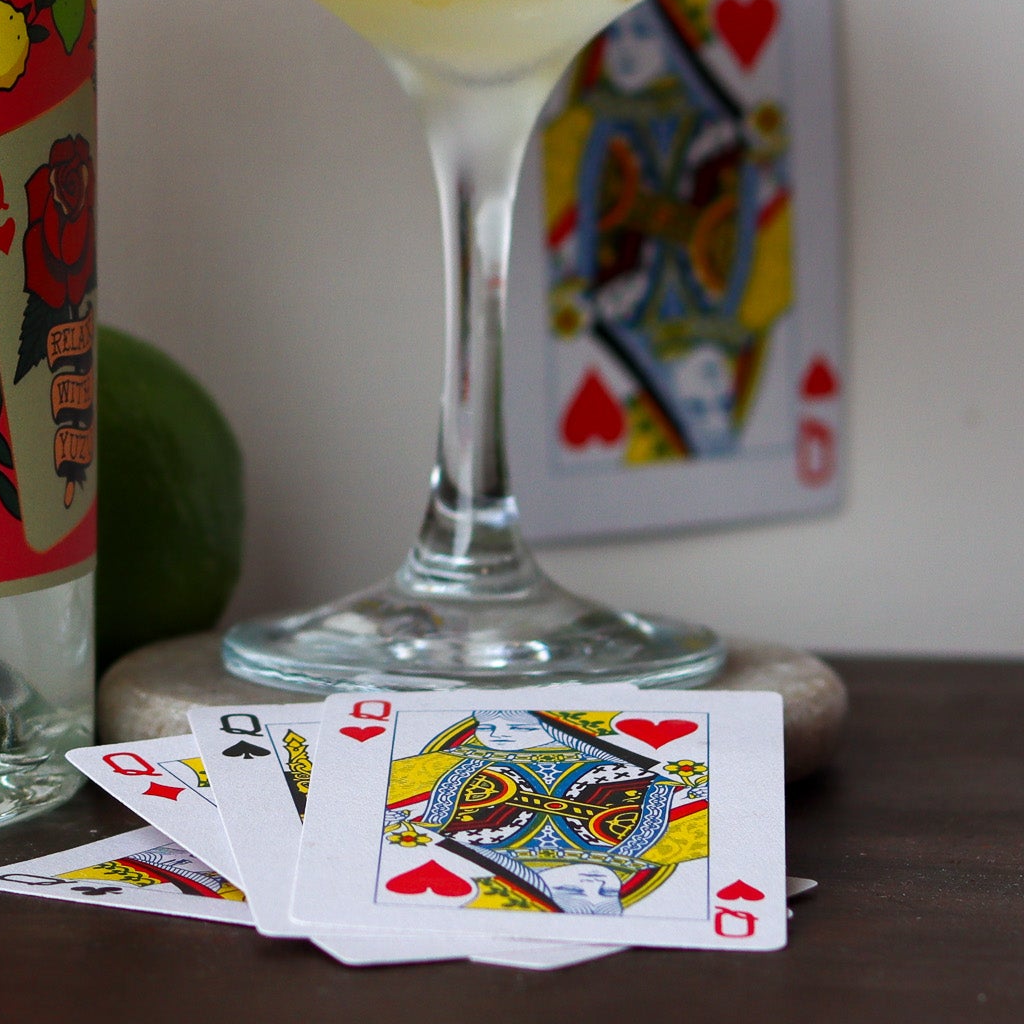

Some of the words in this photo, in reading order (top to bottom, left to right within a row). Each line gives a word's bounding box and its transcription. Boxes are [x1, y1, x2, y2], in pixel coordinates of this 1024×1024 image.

[348, 699, 393, 722] Q
[219, 712, 264, 737] Q
[102, 751, 164, 777] Q
[714, 905, 759, 939] Q
